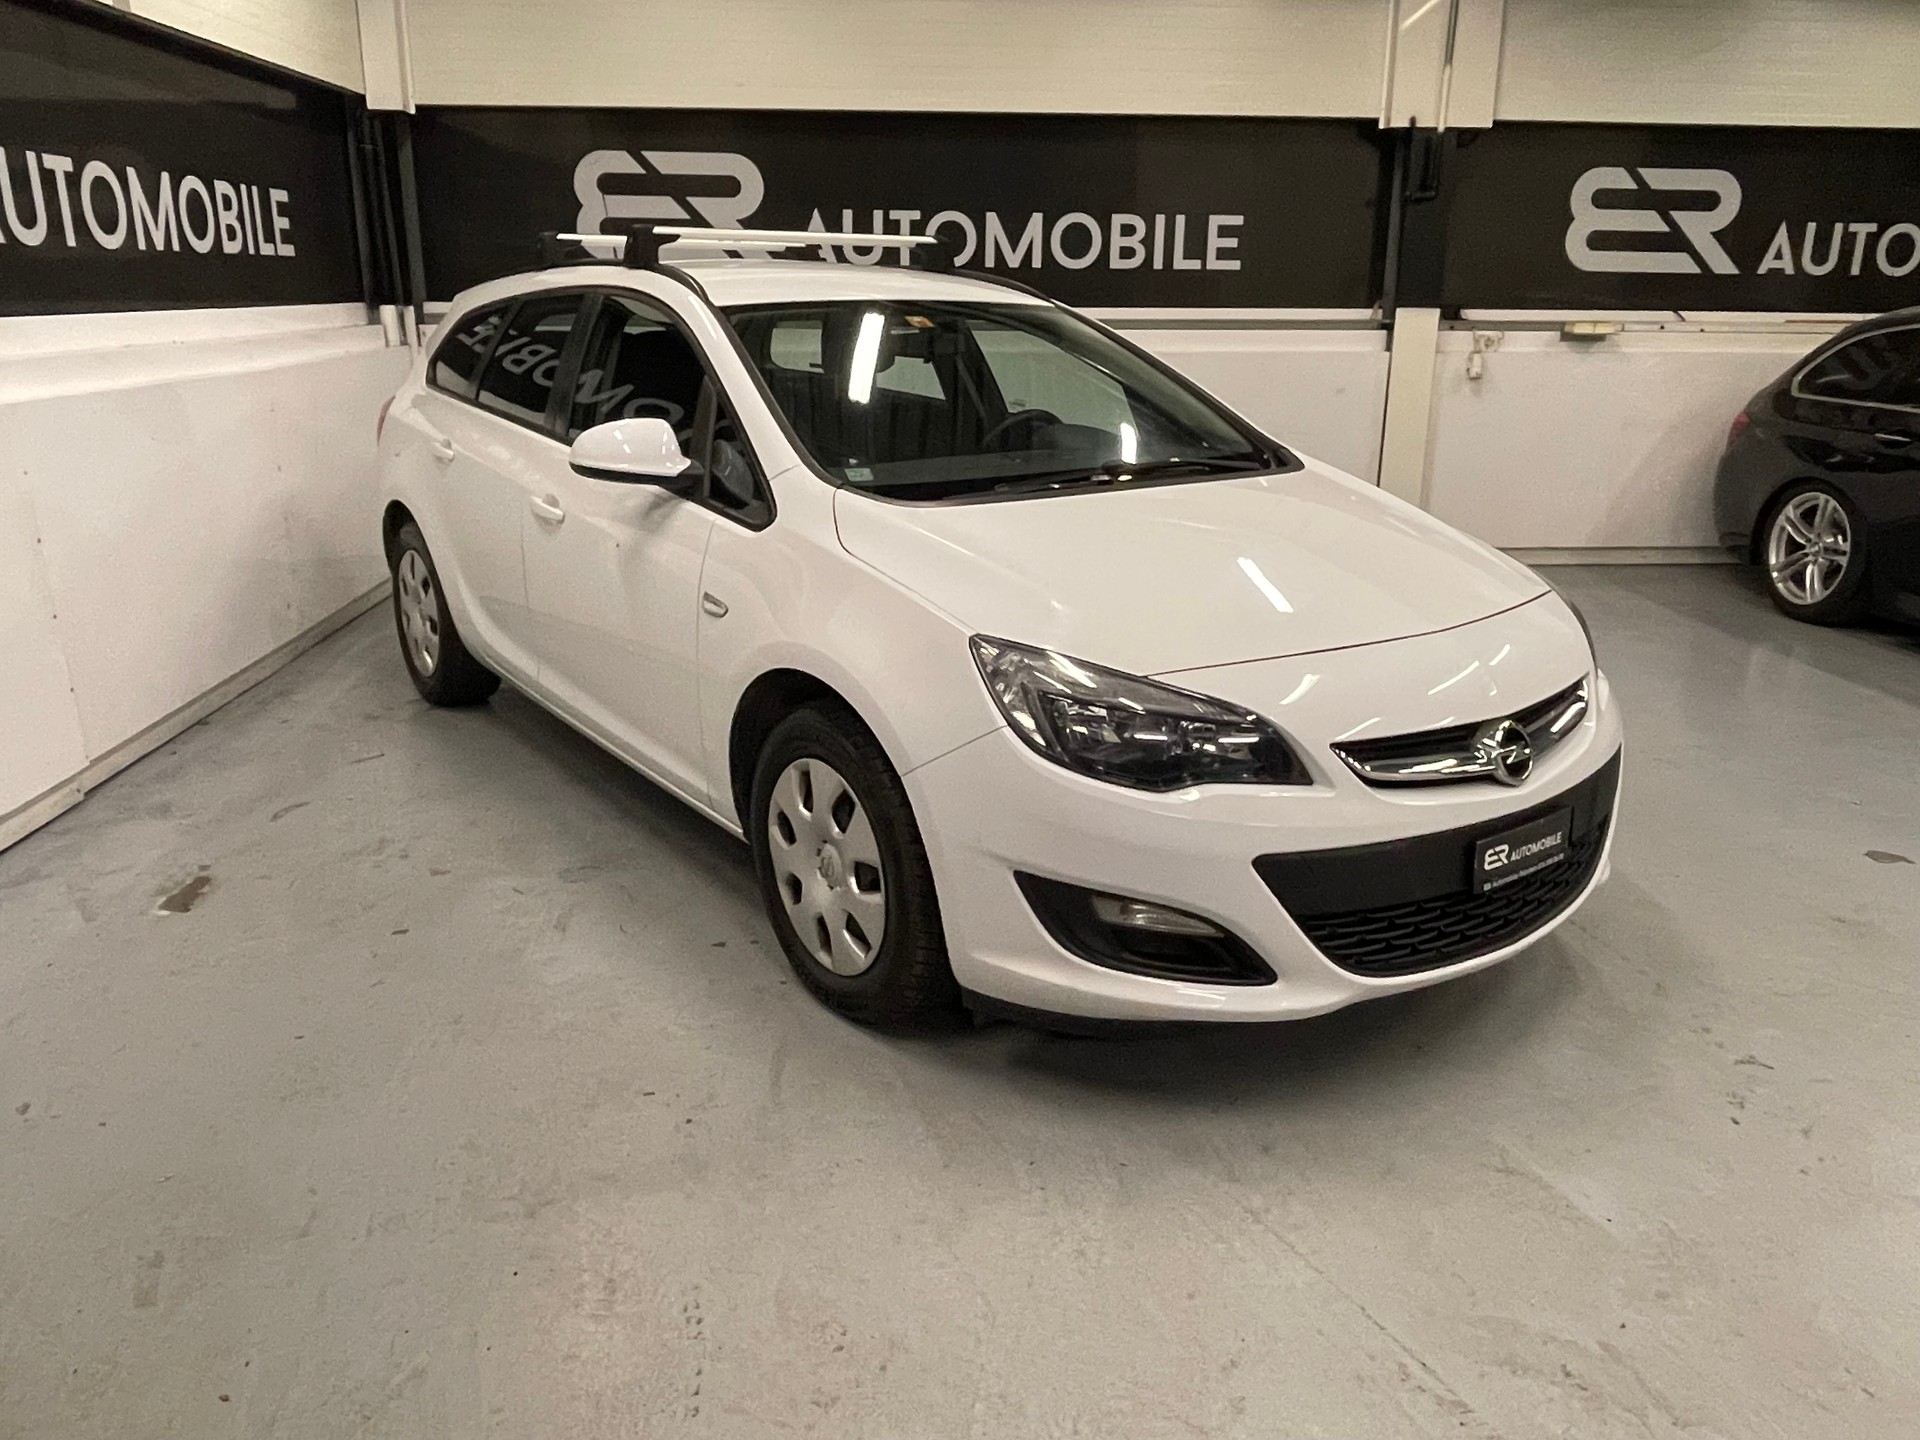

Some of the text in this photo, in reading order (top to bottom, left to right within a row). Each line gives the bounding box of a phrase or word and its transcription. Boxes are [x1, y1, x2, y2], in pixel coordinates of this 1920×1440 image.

[0, 146, 296, 256] UTOMOBILE
[1565, 167, 1742, 275] ER
[1484, 832, 1562, 870] ER AUTOMOBILE
